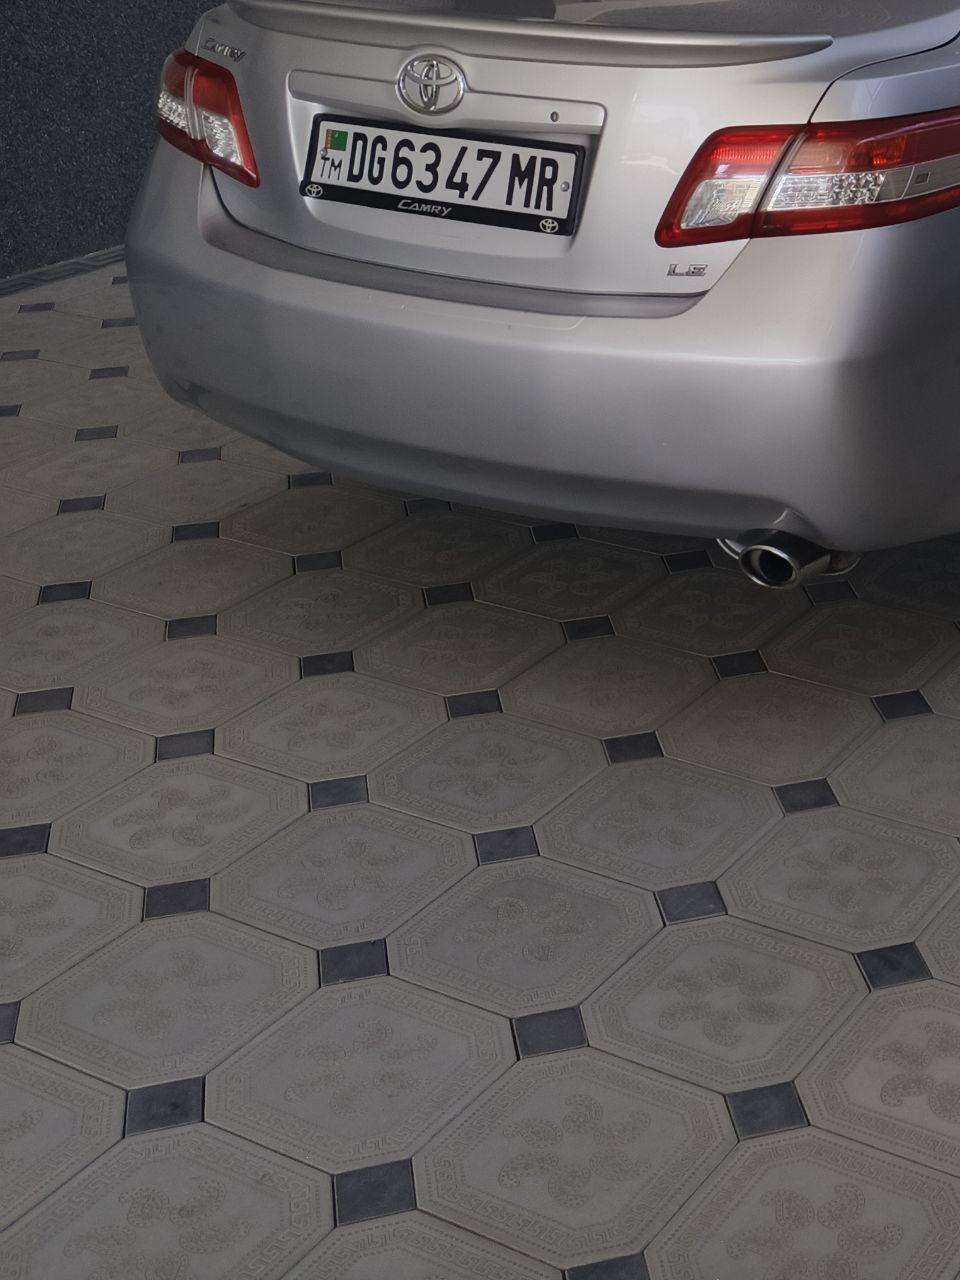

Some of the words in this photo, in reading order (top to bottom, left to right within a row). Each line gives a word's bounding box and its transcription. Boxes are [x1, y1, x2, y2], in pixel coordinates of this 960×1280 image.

[320, 156, 342, 180] TM
[397, 199, 452, 216] CAMRY
[667, 263, 708, 277] LE
